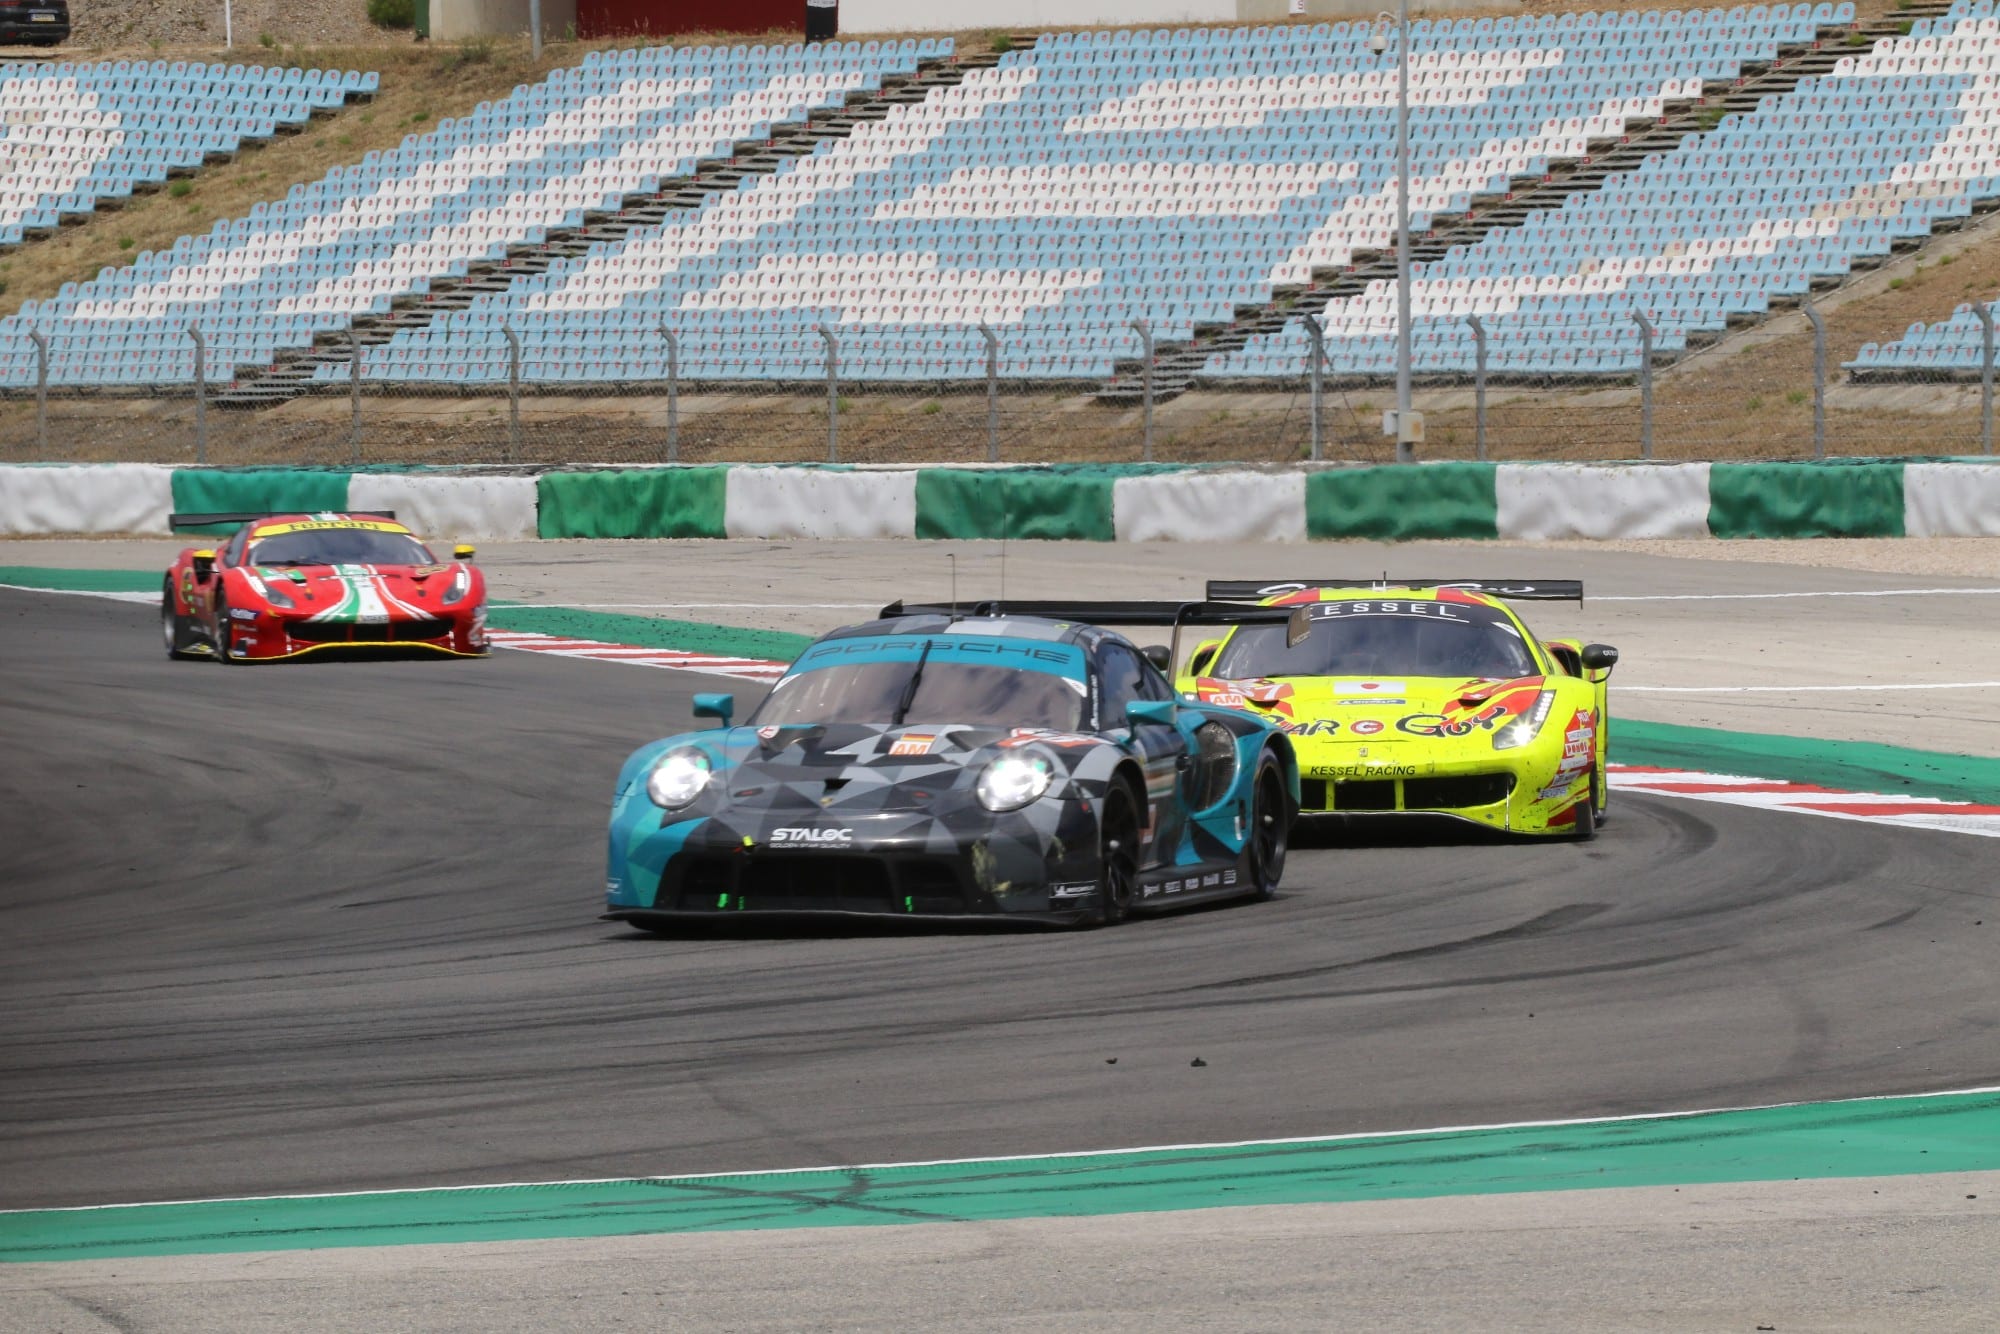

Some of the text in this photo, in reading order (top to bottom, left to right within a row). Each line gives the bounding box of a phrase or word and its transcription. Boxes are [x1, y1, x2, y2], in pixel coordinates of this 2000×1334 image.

[289, 521, 381, 531] Ferrari
[1308, 602, 1457, 618] ESSEL
[808, 641, 1072, 664] PORSCHE
[1213, 695, 1243, 705] AM
[894, 743, 928, 755] AM
[1310, 765, 1416, 777] KESSEL RACING
[769, 827, 854, 842] STALOC
